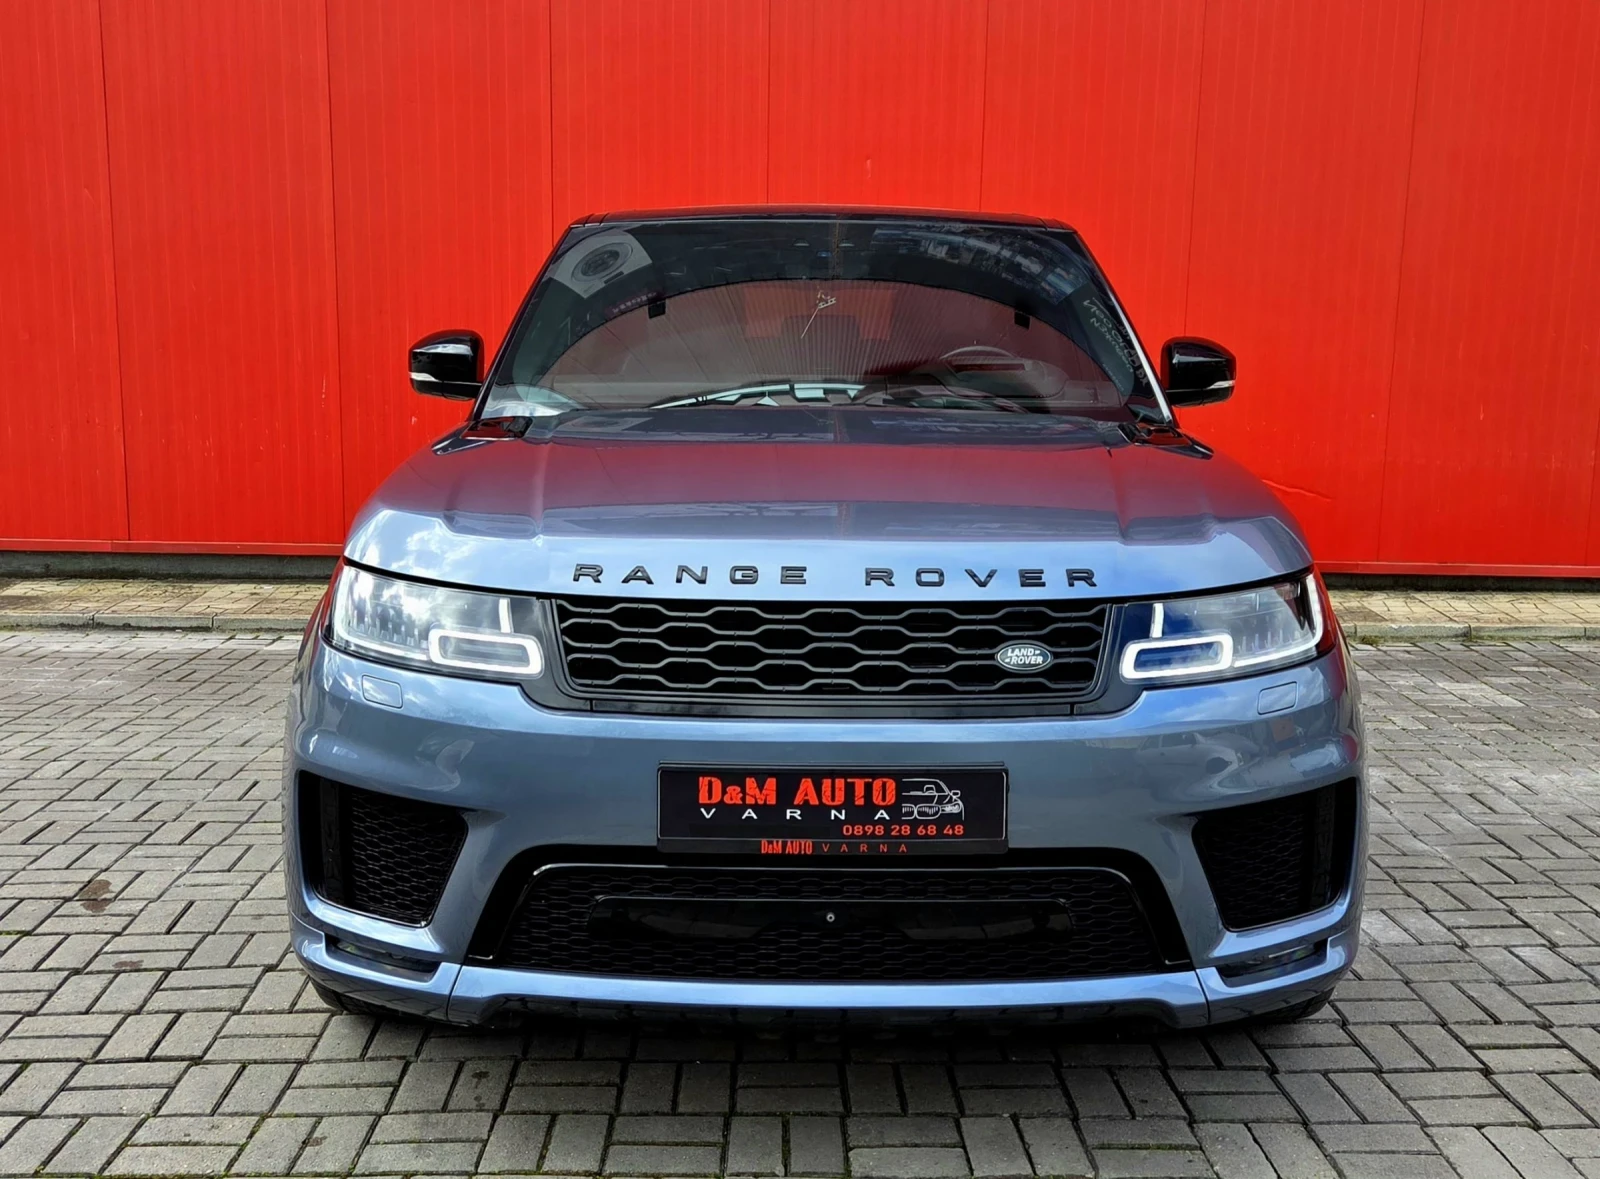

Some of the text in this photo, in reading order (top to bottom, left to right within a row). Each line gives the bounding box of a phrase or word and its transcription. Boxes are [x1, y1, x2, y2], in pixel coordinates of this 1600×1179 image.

[572, 564, 1098, 588] RANGE ROVER
[1007, 648, 1034, 657] LAND
[1011, 656, 1043, 665] ROVER
[698, 776, 897, 806] D&M AUTO
[700, 807, 890, 820] VARNA
[842, 824, 964, 836] 0898 28 68 48
[761, 839, 908, 855] D&M AUTO VARNA
